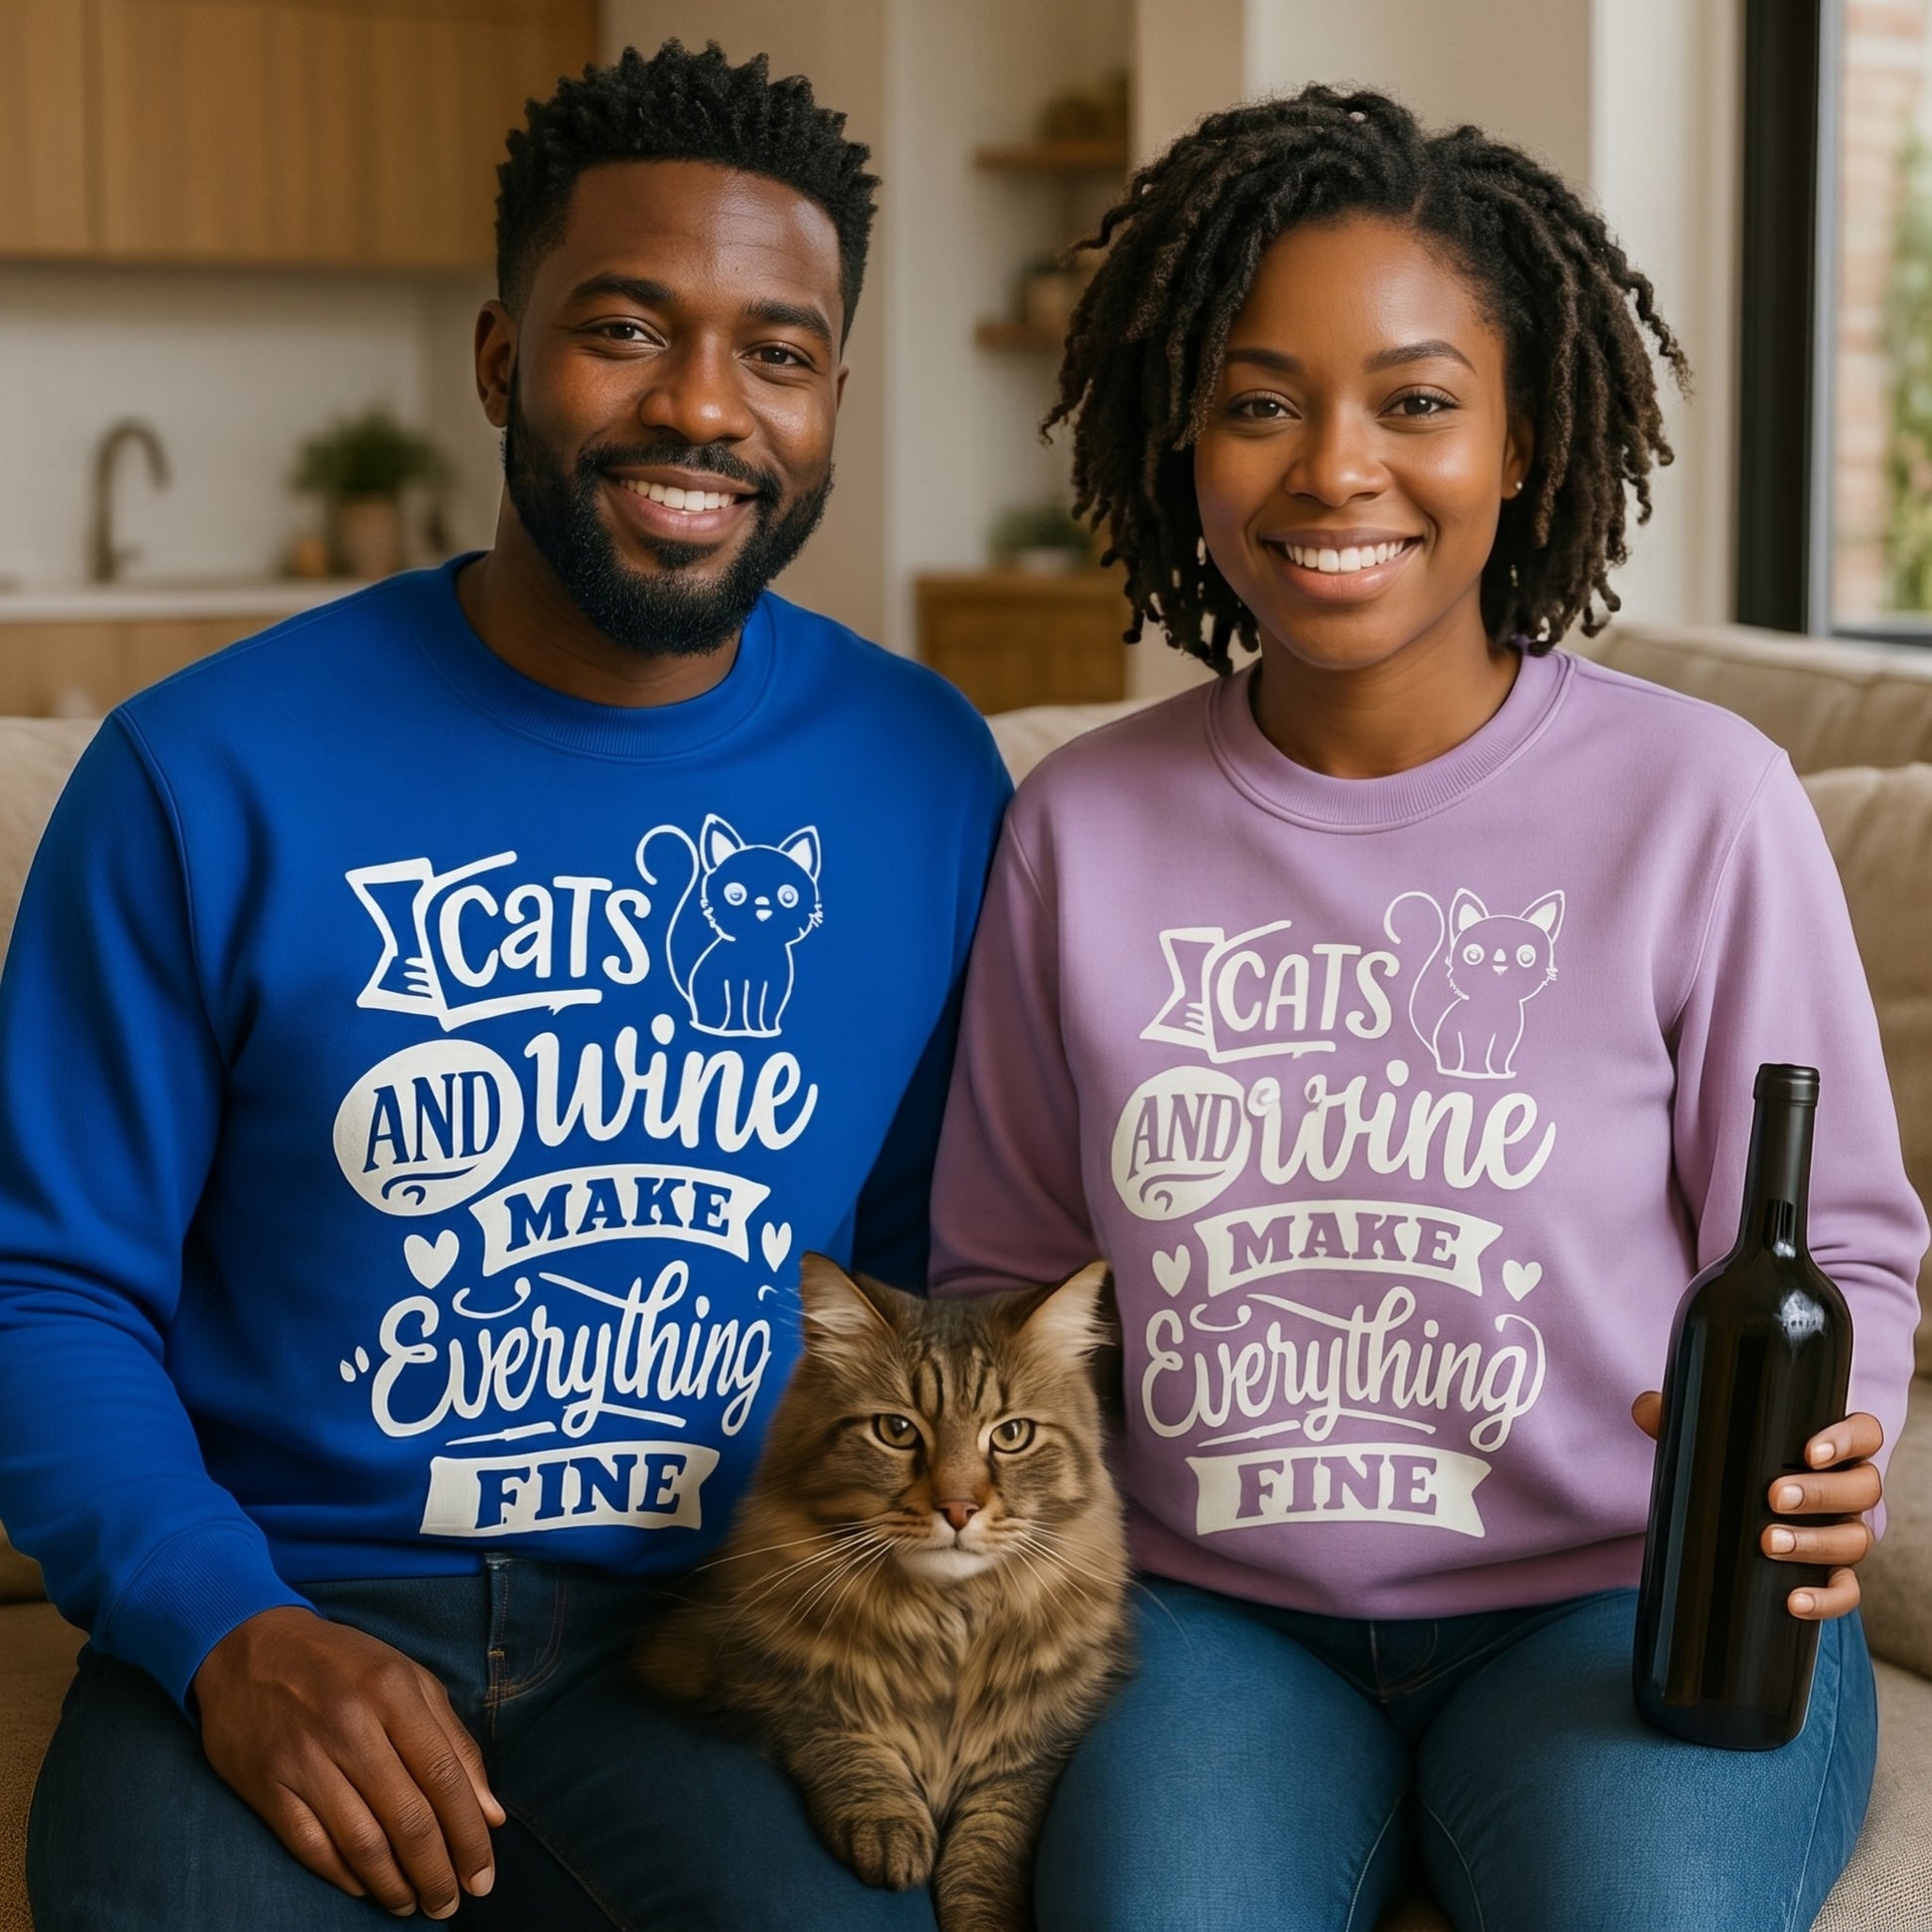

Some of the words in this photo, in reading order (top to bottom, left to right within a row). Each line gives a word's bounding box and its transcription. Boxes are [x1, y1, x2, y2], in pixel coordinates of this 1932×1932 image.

[1216, 944, 1400, 1039] CATS
[362, 1070, 500, 1173] AND
[1127, 1093, 1242, 1182] AND
[504, 1176, 733, 1252] MAKE
[1227, 1212, 1460, 1275] MAKE
[371, 1260, 771, 1438] Everything
[1142, 1287, 1547, 1451] Everything
[476, 1453, 687, 1530] FINE
[1236, 1454, 1437, 1520] FINE
